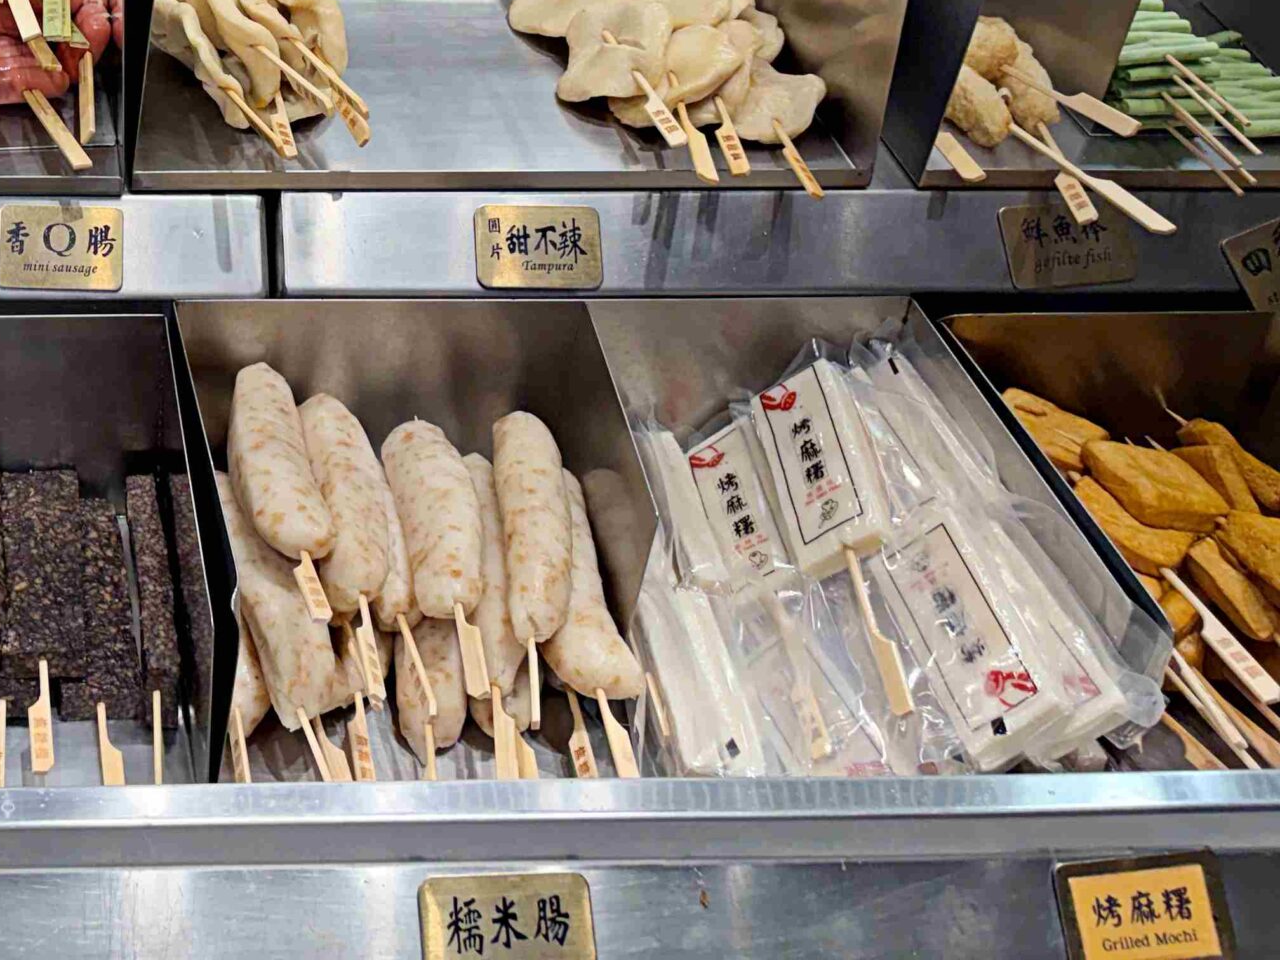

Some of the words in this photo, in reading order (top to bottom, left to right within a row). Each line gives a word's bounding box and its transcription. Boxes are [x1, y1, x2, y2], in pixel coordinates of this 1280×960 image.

[505, 216, 588, 264] 甜不辣
[52, 261, 98, 278] sausage
[521, 259, 575, 275] Tampura
[791, 416, 825, 484] 烤麻糬
[717, 471, 757, 539] 烤麻糬
[447, 894, 570, 956] 糯米腸
[1091, 886, 1193, 929] 烤麻糬
[1102, 932, 1150, 952] Grilled
[1155, 928, 1199, 947] Mochi
